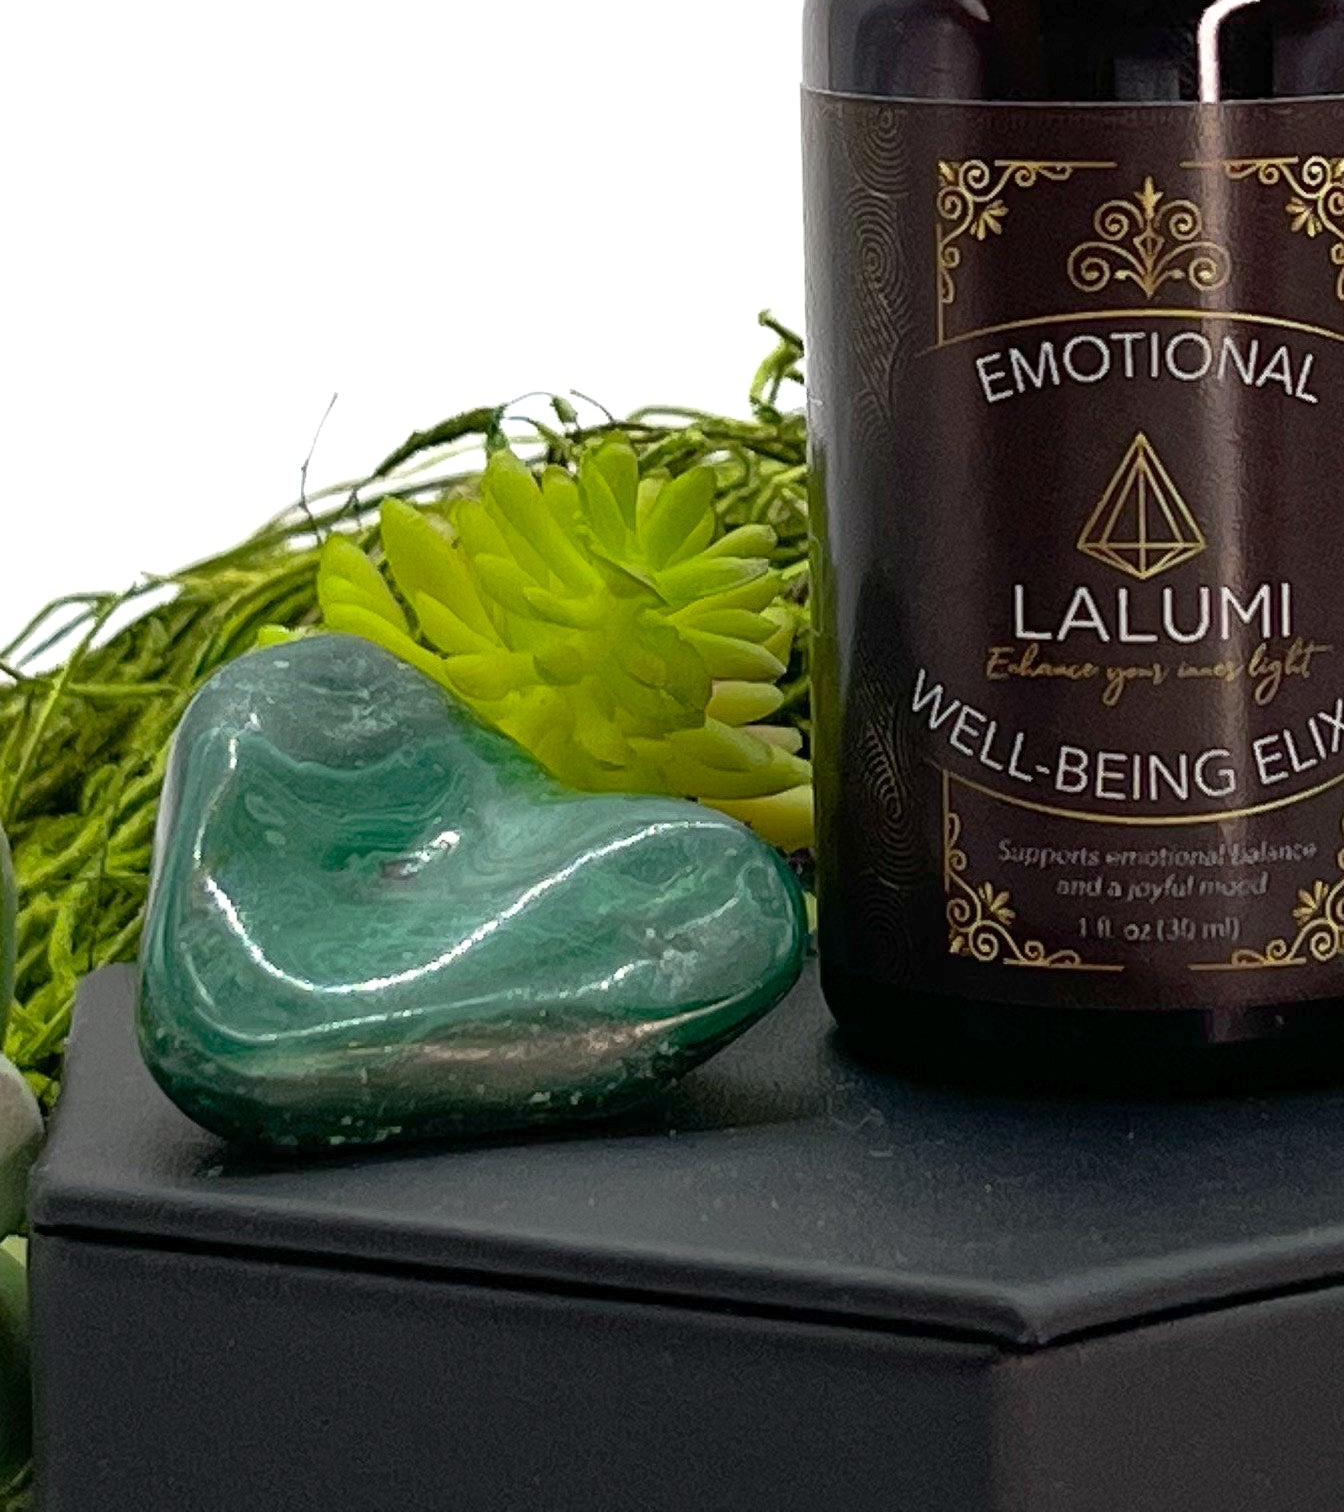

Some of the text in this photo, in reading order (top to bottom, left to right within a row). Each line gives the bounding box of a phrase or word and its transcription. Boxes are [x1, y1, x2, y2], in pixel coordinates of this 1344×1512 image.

[976, 331, 1319, 404] EMOTIONAL
[1014, 582, 1291, 643] LALUMI
[984, 637, 1334, 707] Enhance your inner light
[911, 669, 1237, 801] WELL-BEING
[998, 840, 1318, 869] Supports emotional balance
[1056, 871, 1269, 904] and a joyful mood
[1078, 916, 1088, 938] 1
[1122, 922, 1151, 941] oz
[1156, 916, 1197, 941] (30
[1201, 916, 1241, 940] ml)
